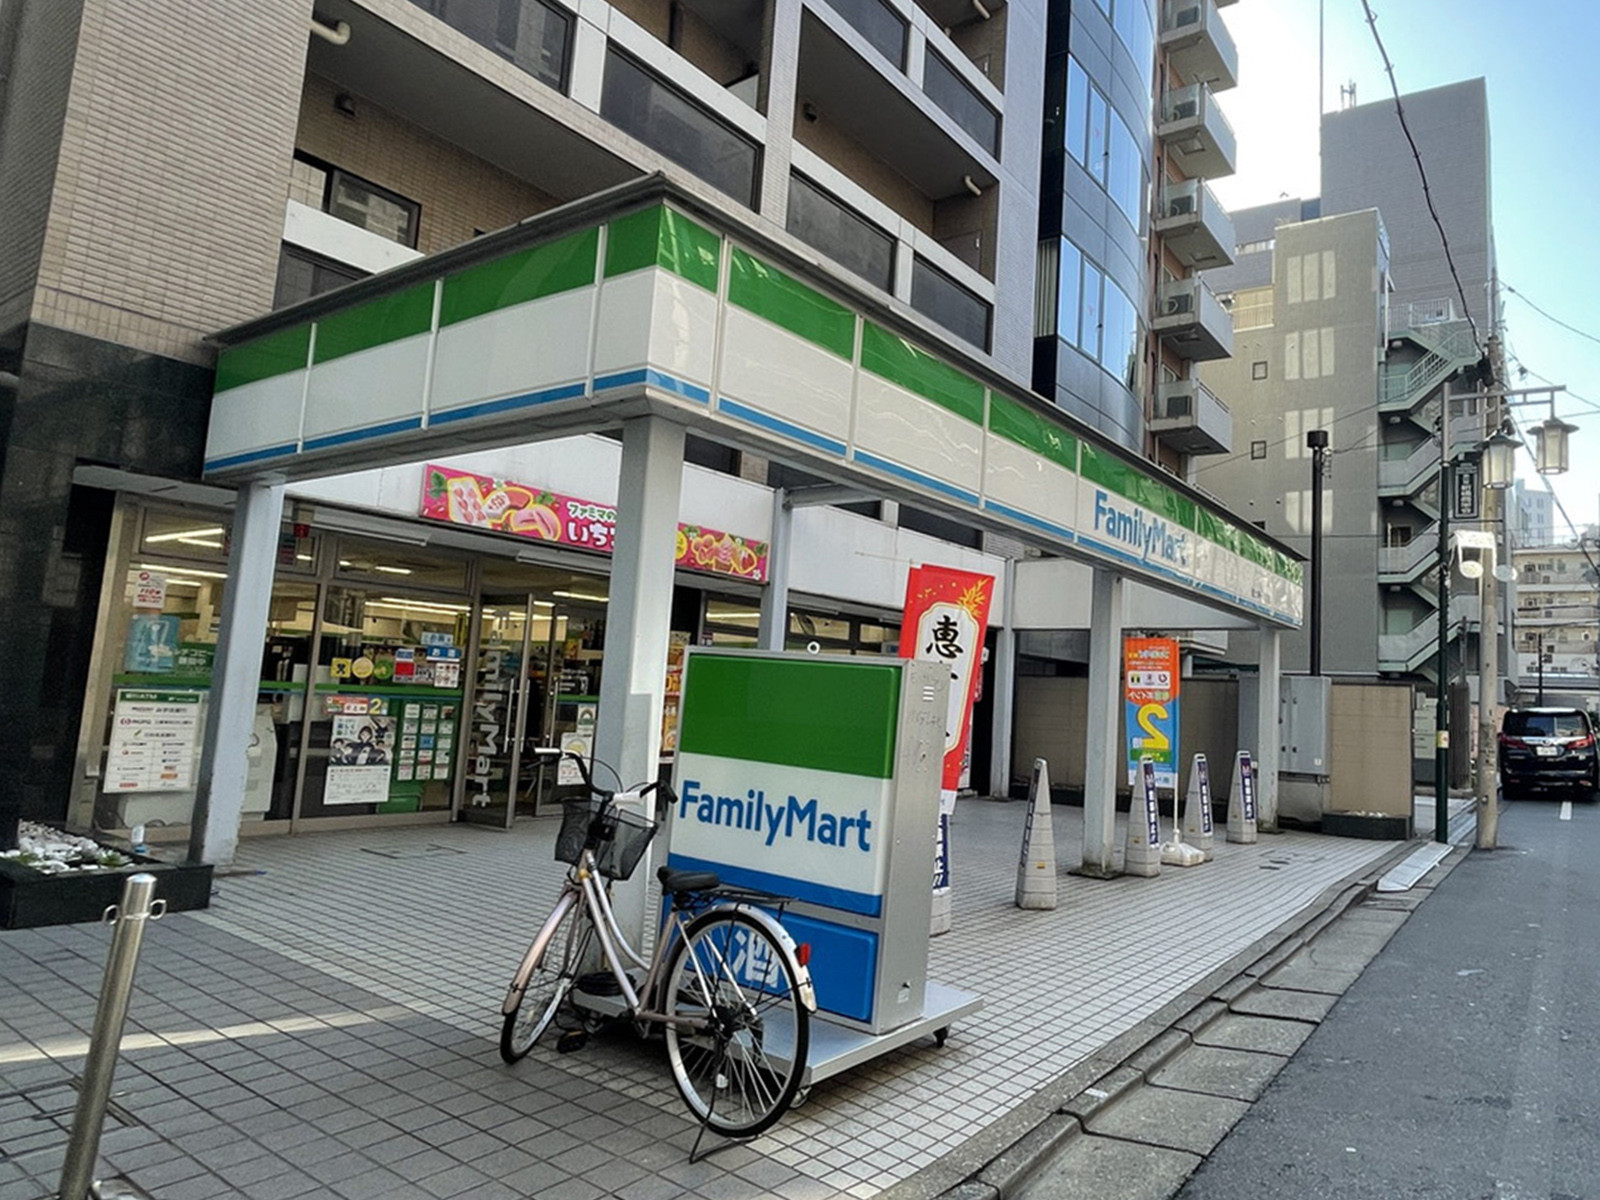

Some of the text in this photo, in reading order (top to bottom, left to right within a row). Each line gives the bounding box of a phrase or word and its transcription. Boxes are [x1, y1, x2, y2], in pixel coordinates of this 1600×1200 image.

[567, 501, 616, 523] ファミマの
[1094, 490, 1187, 565] FamilyMart
[679, 779, 872, 852] FamilyMart
